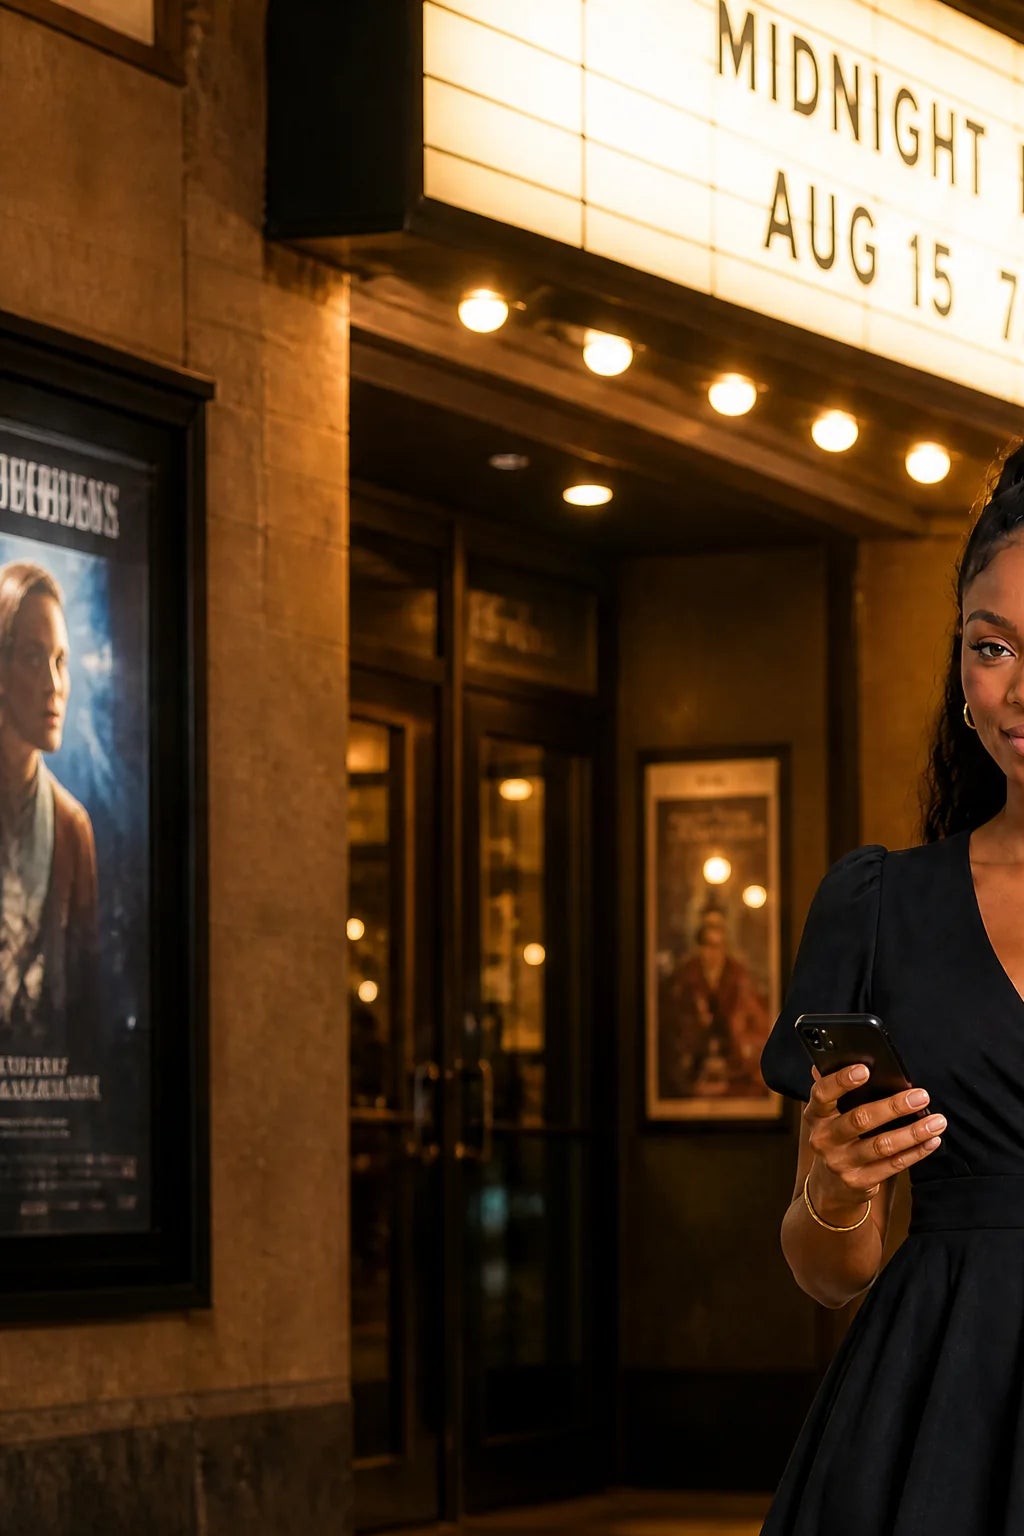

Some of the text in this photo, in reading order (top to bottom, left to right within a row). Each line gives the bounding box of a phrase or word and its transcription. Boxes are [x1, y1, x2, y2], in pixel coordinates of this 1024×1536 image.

[718, 0, 985, 196] MIDNIGHT
[764, 170, 876, 285] AUG
[910, 234, 953, 317] 15
